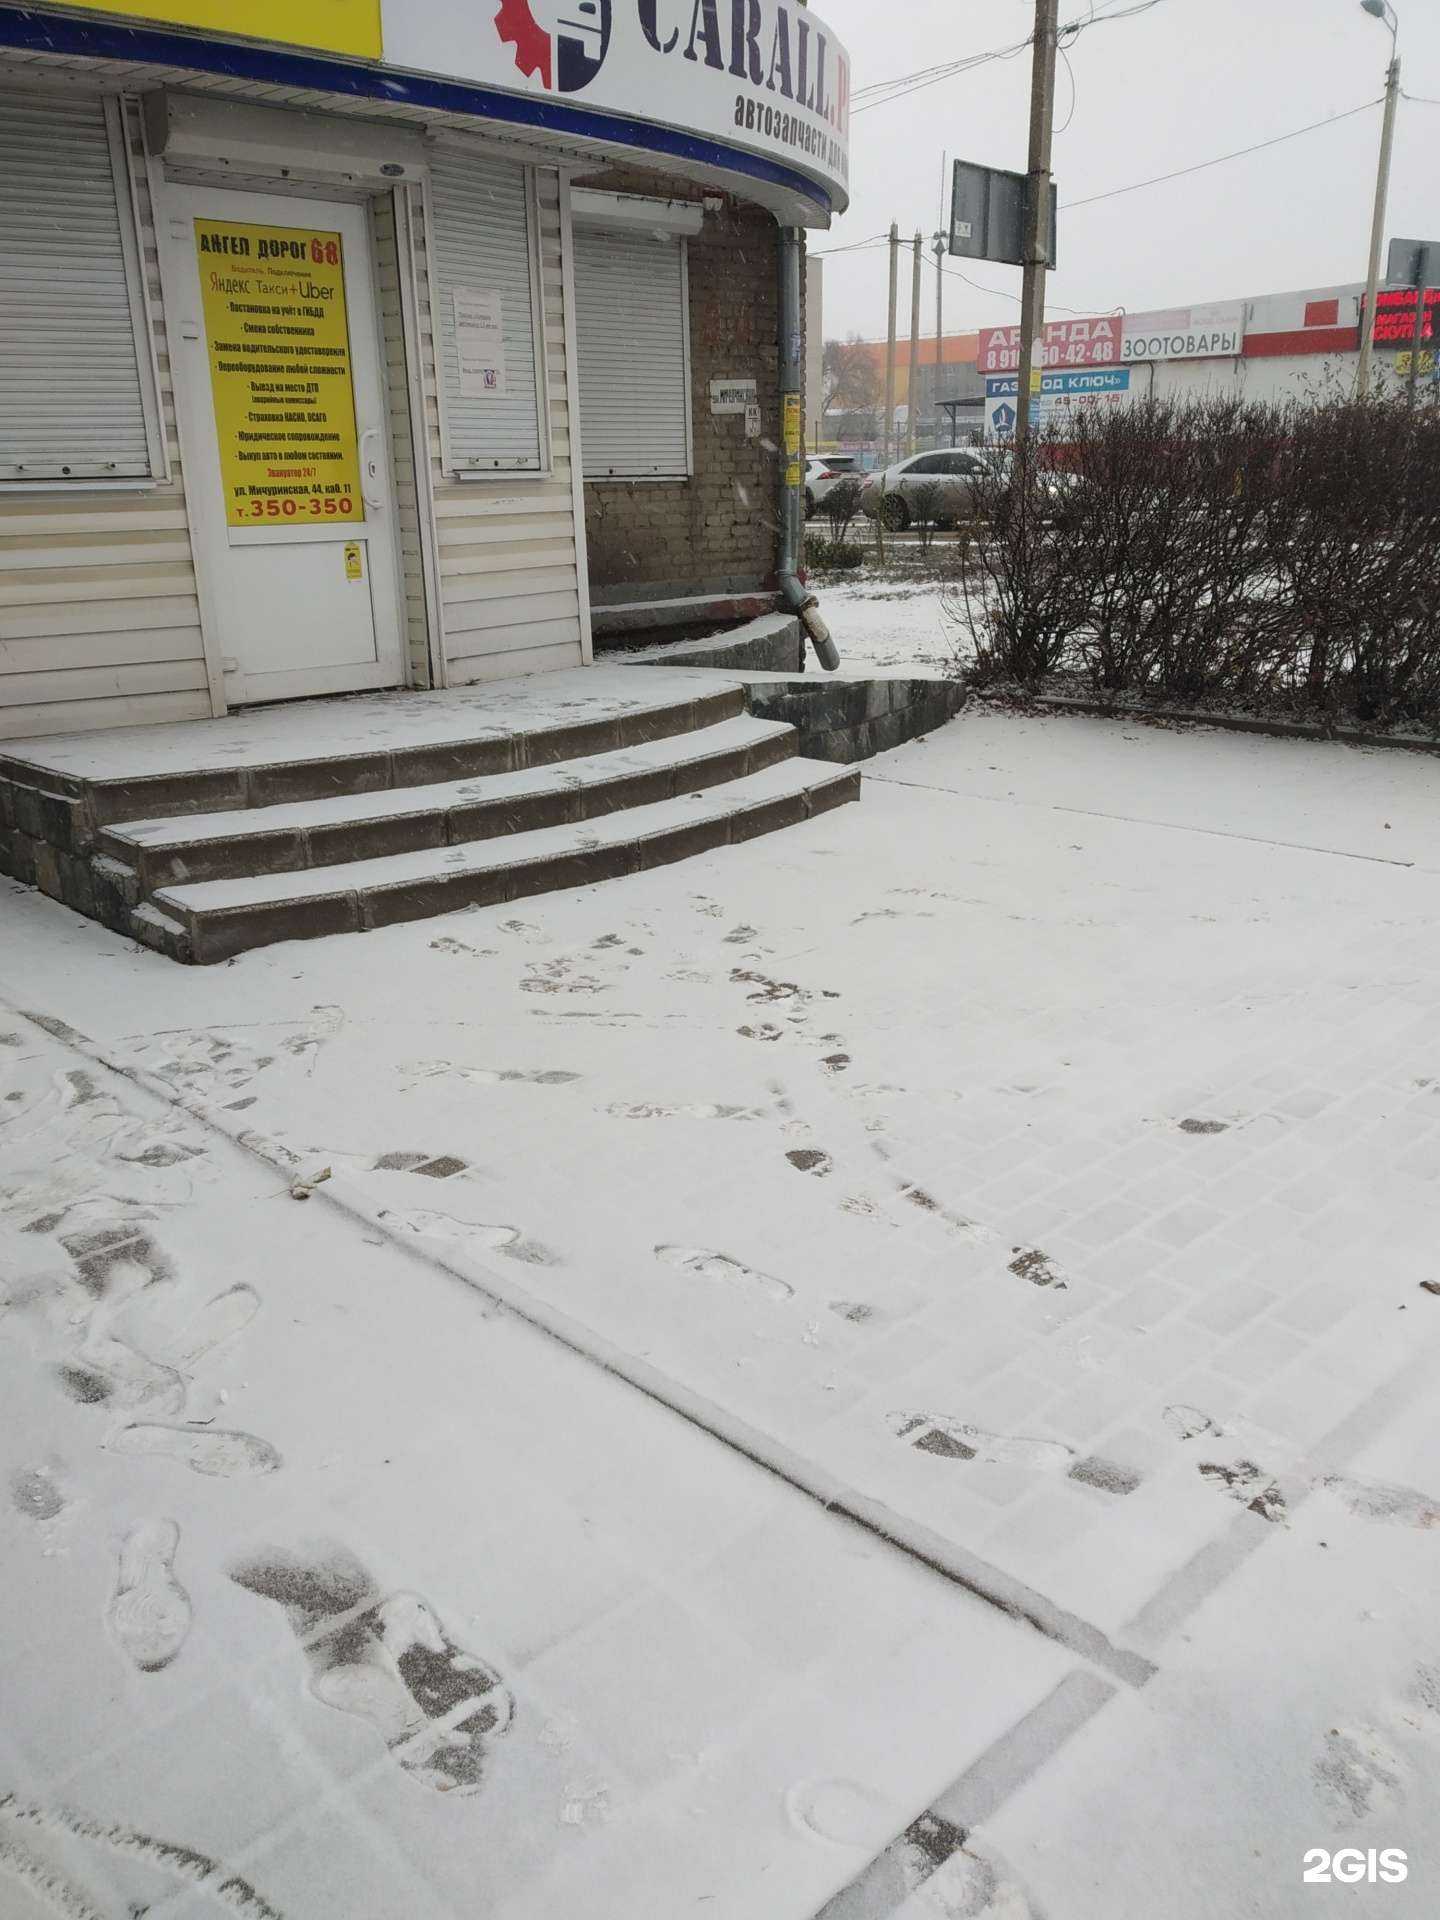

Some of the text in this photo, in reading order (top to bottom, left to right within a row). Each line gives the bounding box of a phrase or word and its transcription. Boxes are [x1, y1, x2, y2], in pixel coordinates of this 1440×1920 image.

[734, 94, 827, 161] автозапчасти
[200, 234, 339, 266] АНГЕЛ ДОРОГ 68
[210, 272, 251, 295] Яндекс
[230, 302, 271, 315] Постановка
[271, 306, 281, 315] на
[303, 306, 324, 319] ГИБДД
[243, 322, 315, 336] Смена собственника
[988, 320, 1115, 348] АРНДА
[214, 341, 346, 357] Замена водительского удостоверения
[1123, 332, 1237, 358] ЗООТОВАРЫ
[218, 361, 285, 373] Переоборудование
[309, 365, 346, 375] сложности
[250, 381, 319, 393] Выезд на место ДТП
[1042, 378, 1064, 390] ОД
[248, 412, 284, 422] Страховка
[238, 431, 340, 442] Юридическое сопровождение
[238, 451, 262, 462] Выкуп
[262, 452, 278, 461] авто
[284, 450, 307, 461] любом
[267, 467, 317, 478] Эвакуатор 24/7
[234, 487, 248, 497] ул.
[325, 484, 342, 494] каб.
[343, 484, 352, 494] 11
